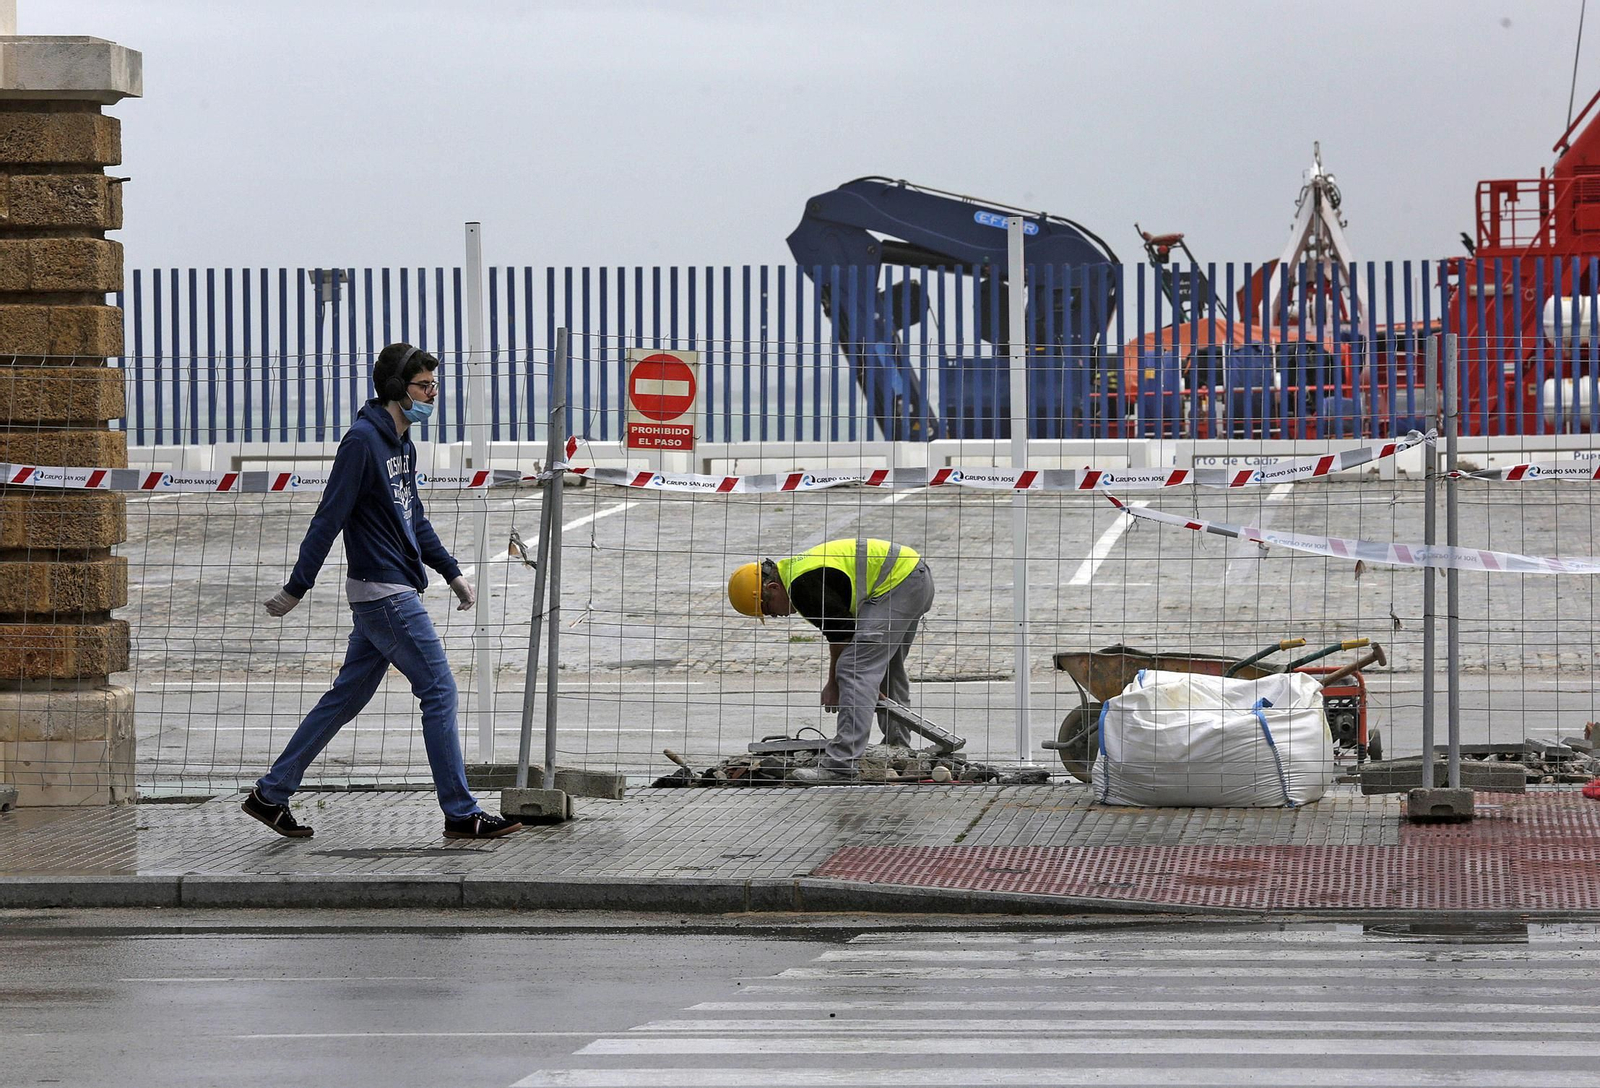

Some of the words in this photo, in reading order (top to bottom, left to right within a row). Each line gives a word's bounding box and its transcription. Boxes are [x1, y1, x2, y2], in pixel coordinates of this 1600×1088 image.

[980, 213, 1035, 234] EFFR
[631, 426, 690, 435] PROHIBIDO
[654, 438, 682, 446] PASO
[1574, 450, 1600, 460] Pue
[1222, 456, 1238, 466] de
